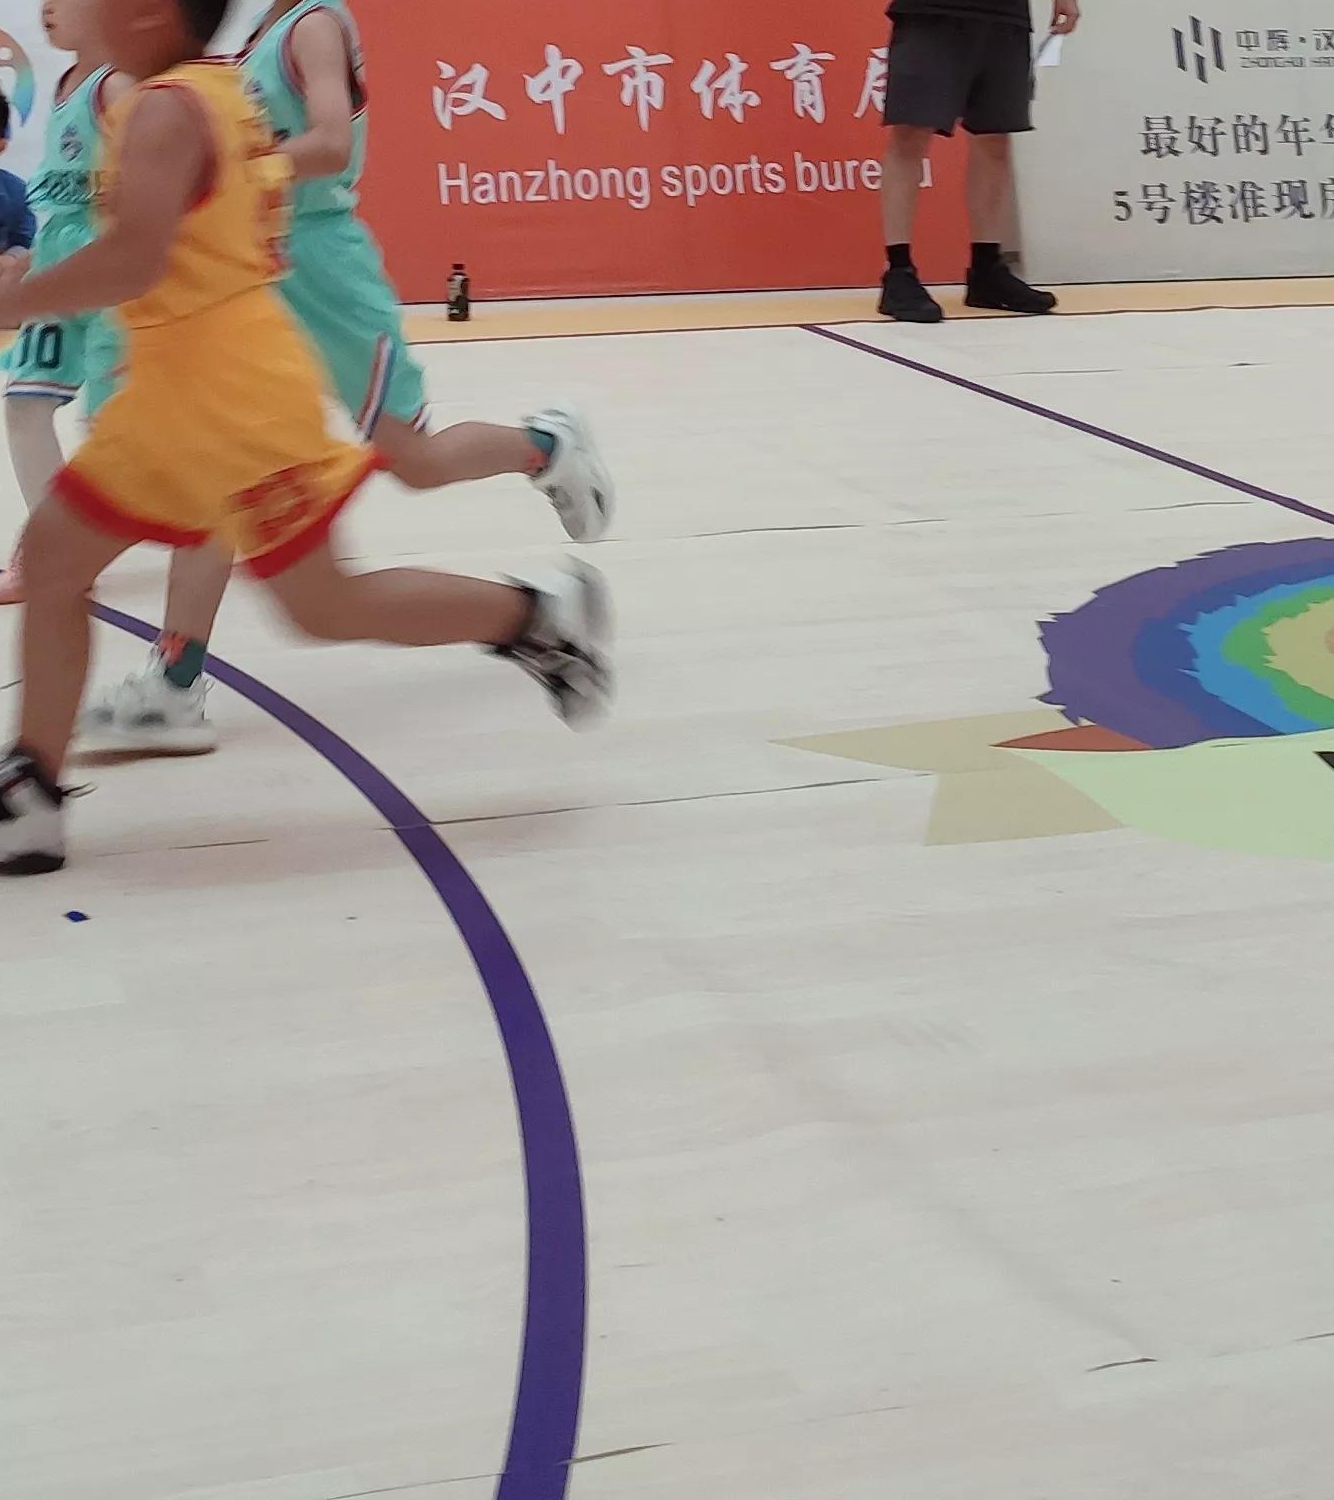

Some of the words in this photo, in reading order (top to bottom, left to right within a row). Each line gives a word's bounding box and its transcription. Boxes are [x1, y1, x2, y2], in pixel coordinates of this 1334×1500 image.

[438, 159, 651, 209] Hanzhong
[661, 156, 787, 206] sports
[794, 151, 933, 191] bure
[17, 322, 64, 369] 10
